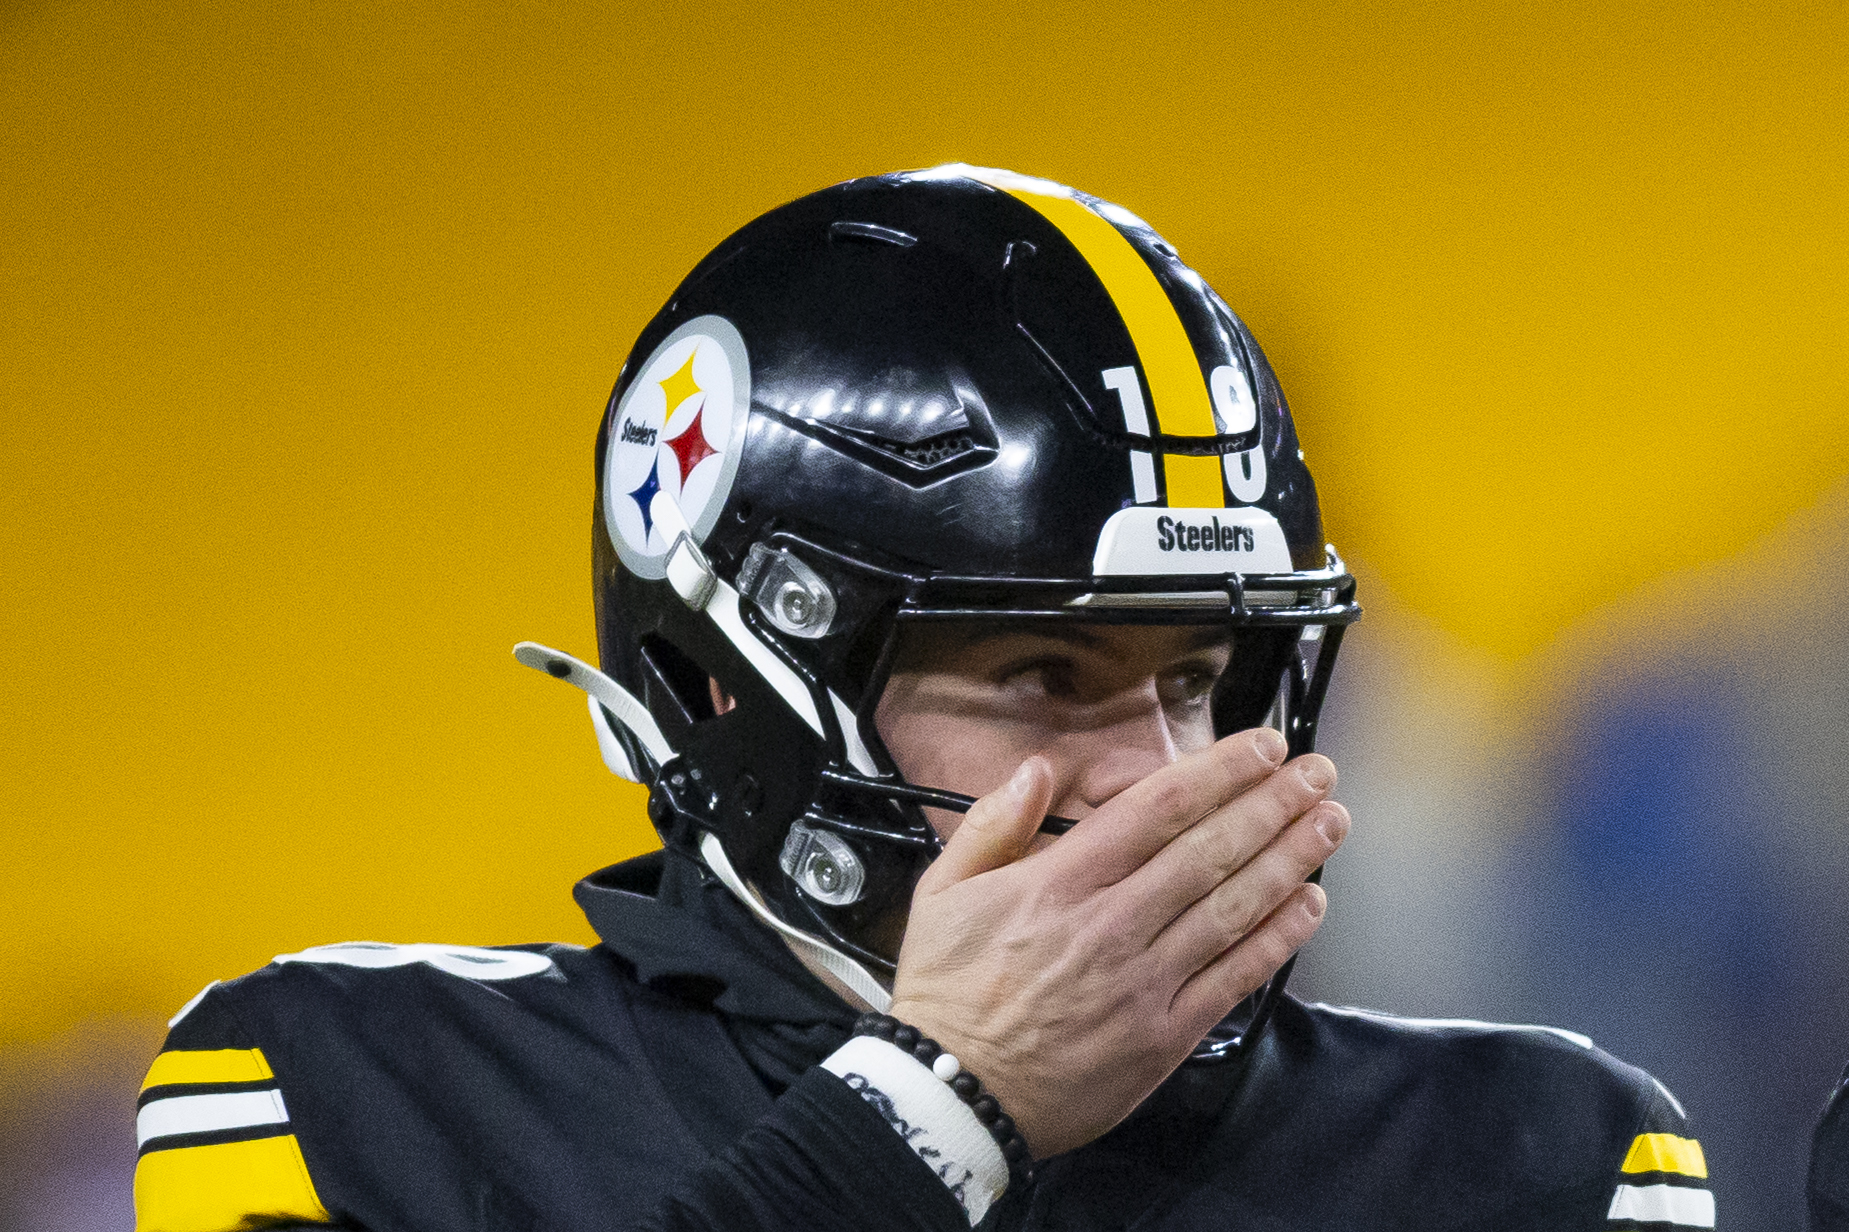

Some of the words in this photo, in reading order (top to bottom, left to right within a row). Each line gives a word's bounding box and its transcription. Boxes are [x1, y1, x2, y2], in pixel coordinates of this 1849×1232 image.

[620, 416, 658, 448] Steelers
[1101, 365, 1267, 504] 18
[1156, 515, 1255, 552] Steelers
